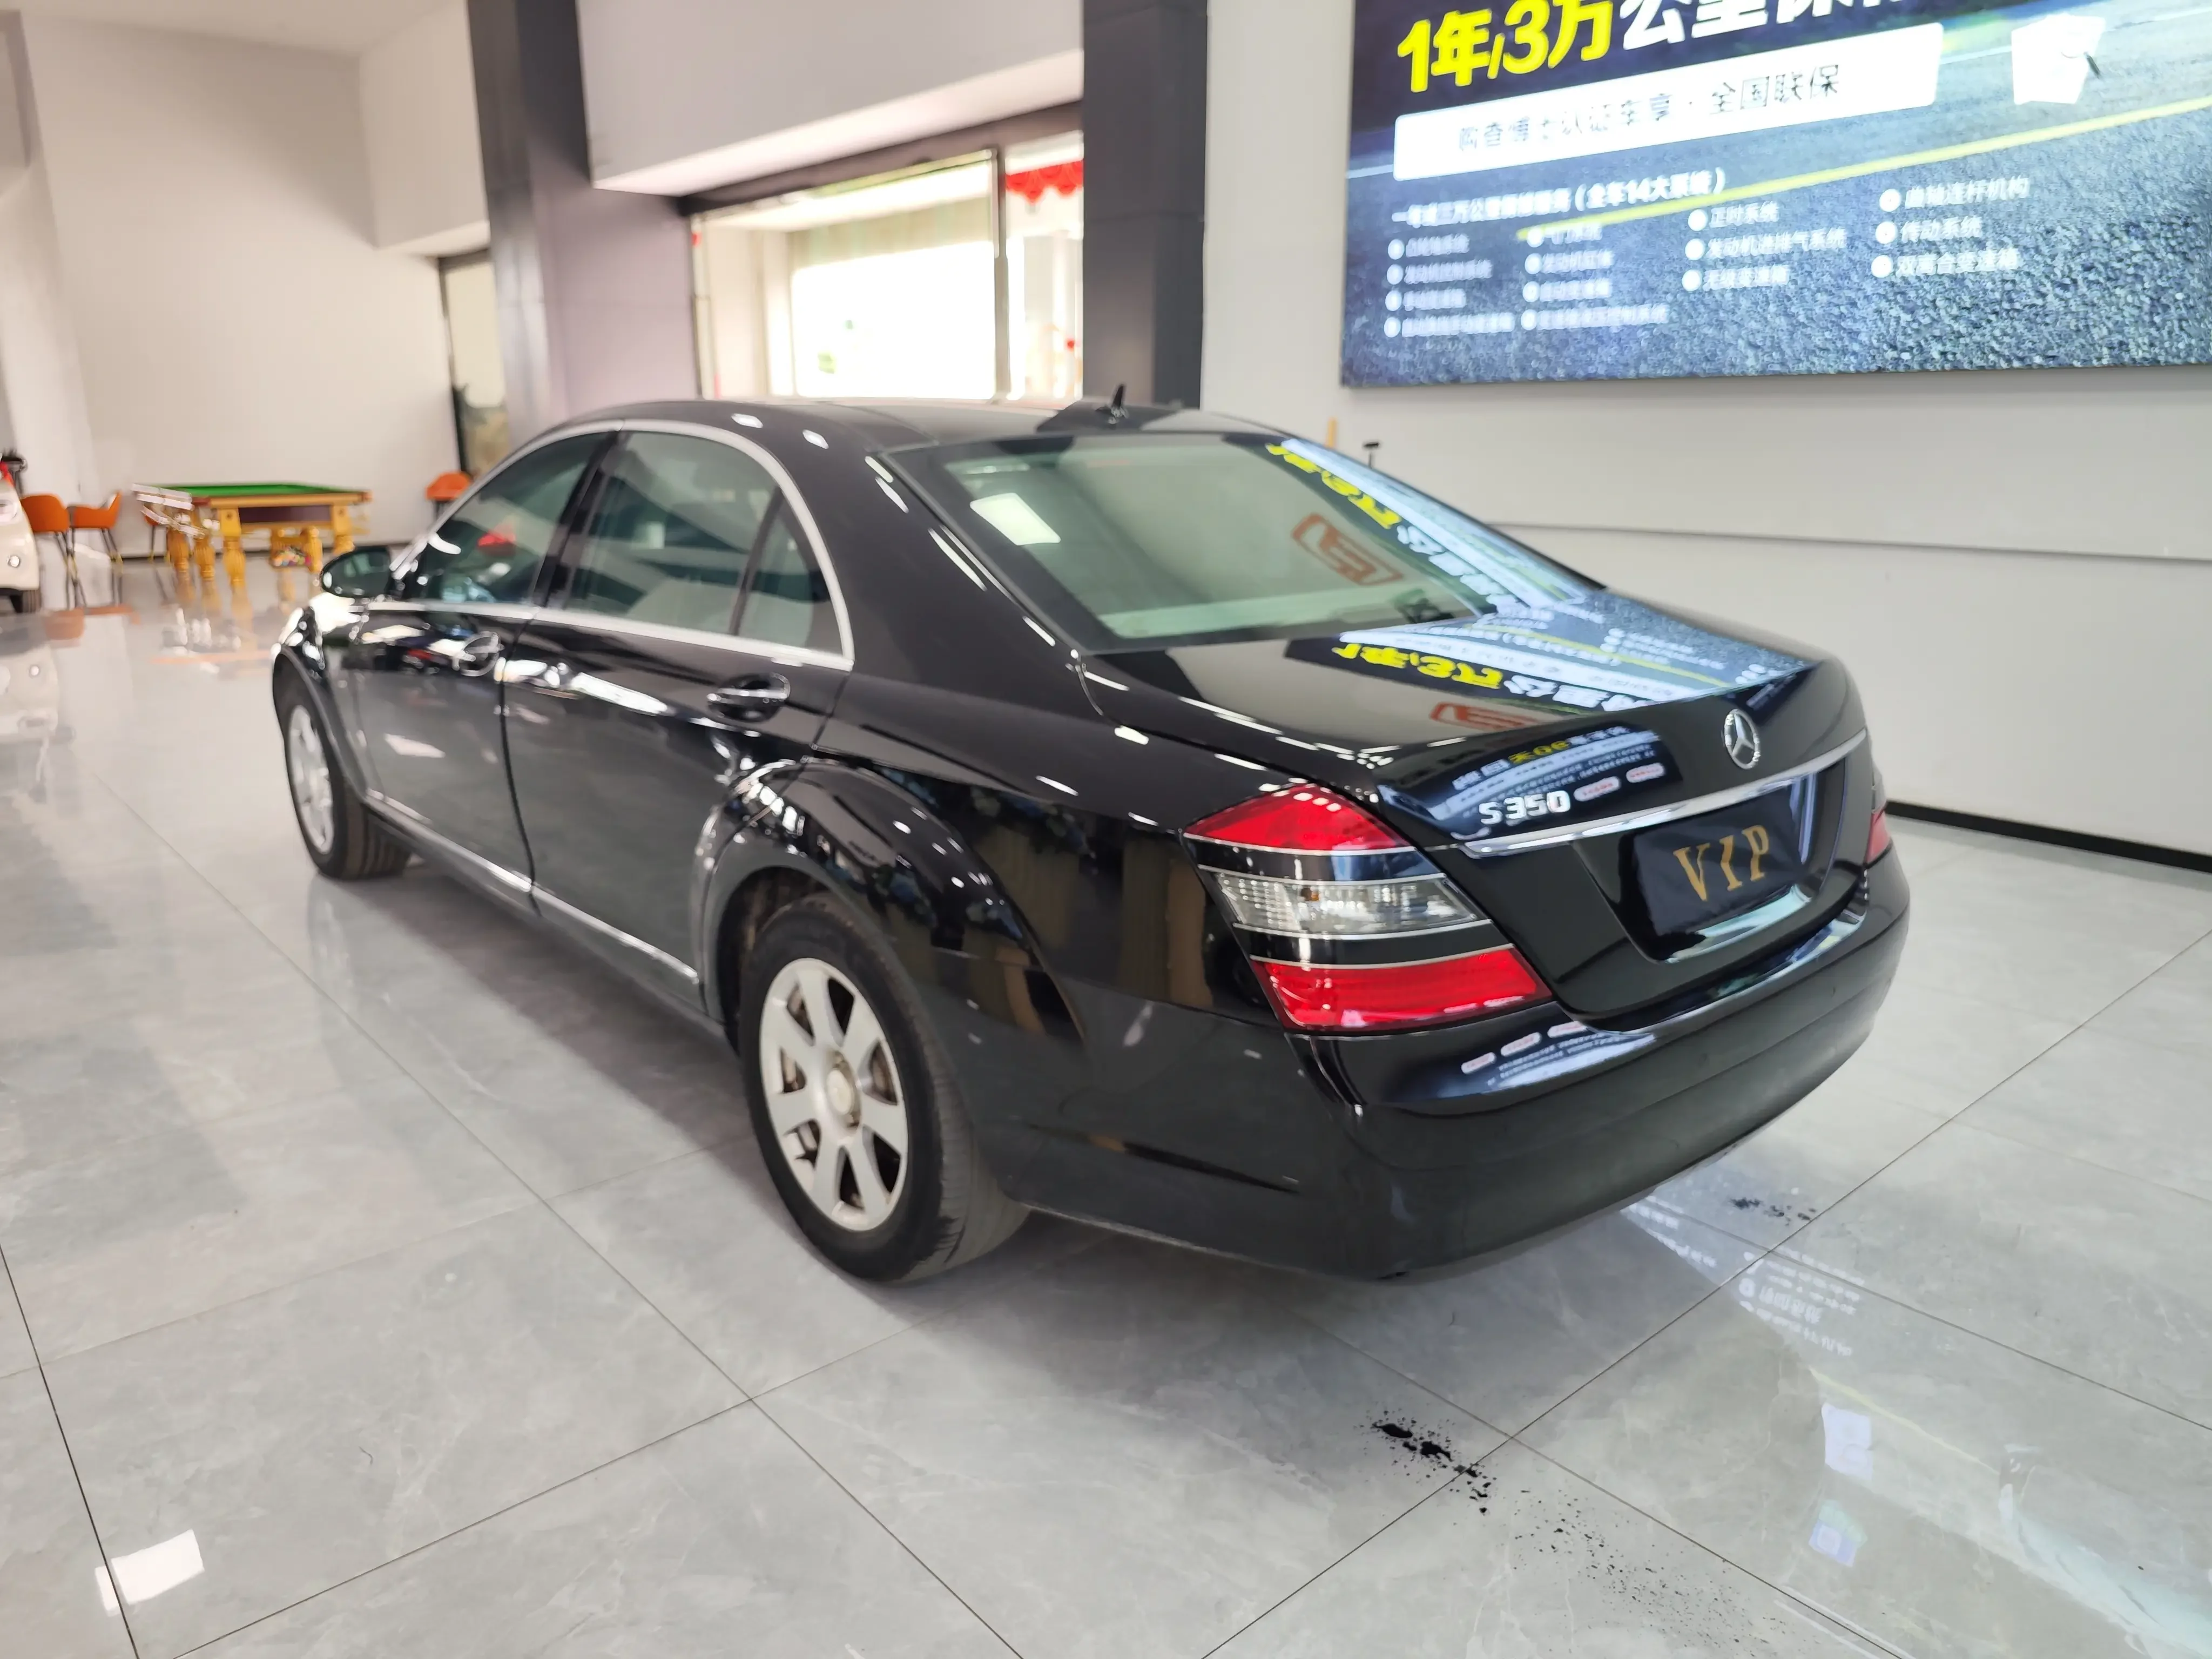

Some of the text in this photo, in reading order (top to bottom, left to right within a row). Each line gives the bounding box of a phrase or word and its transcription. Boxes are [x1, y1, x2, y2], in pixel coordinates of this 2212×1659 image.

[1397, 0, 1904, 92] 1年/3万公里
[1673, 825, 1769, 901] VIP
